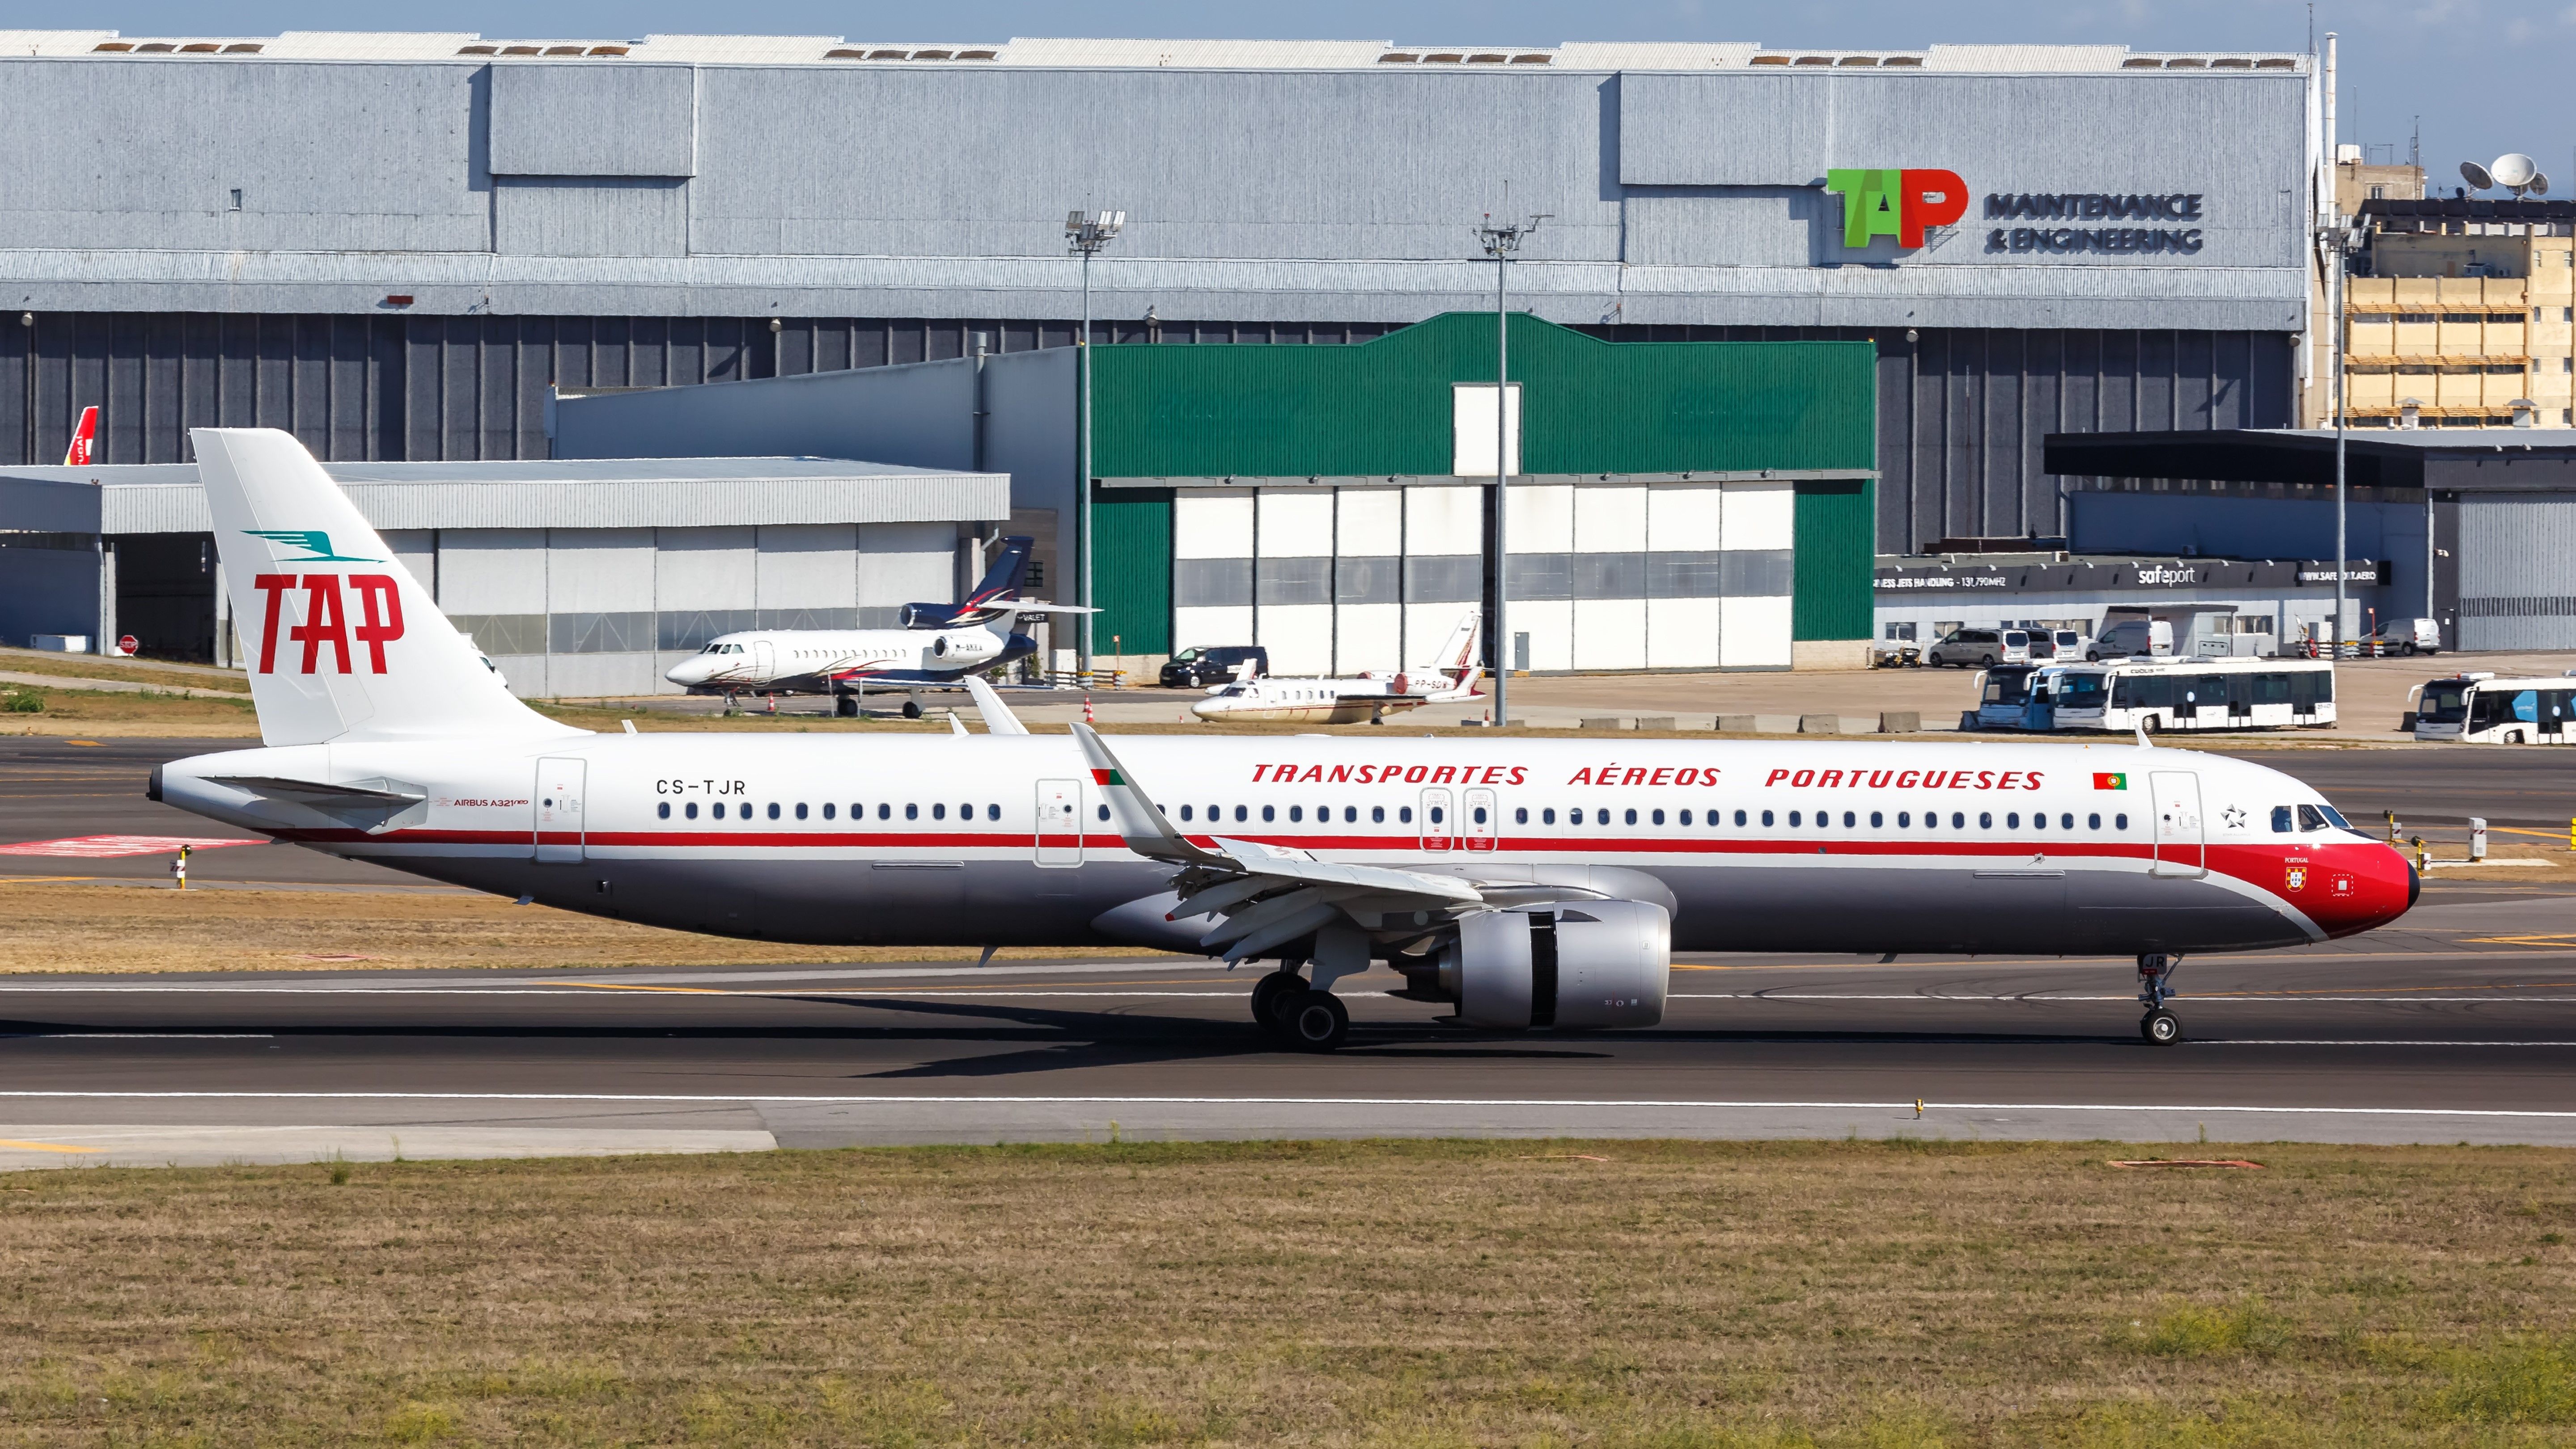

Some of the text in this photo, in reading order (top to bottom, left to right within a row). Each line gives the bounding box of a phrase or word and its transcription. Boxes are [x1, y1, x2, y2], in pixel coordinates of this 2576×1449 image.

[1828, 169, 1968, 248] TAP
[1989, 193, 2203, 217] MAINTENANCE
[1991, 228, 2203, 250] & ENGINEERING
[1896, 578, 1913, 587] JETS
[1914, 578, 1954, 587] HANDLING
[2139, 565, 2196, 587] safeport
[254, 574, 405, 674] TAP
[657, 780, 745, 795] CS-TJR
[1252, 762, 2045, 791] TRANSPORTES AÉREOS PORTUGUESES
[2145, 956, 2165, 967] JR
